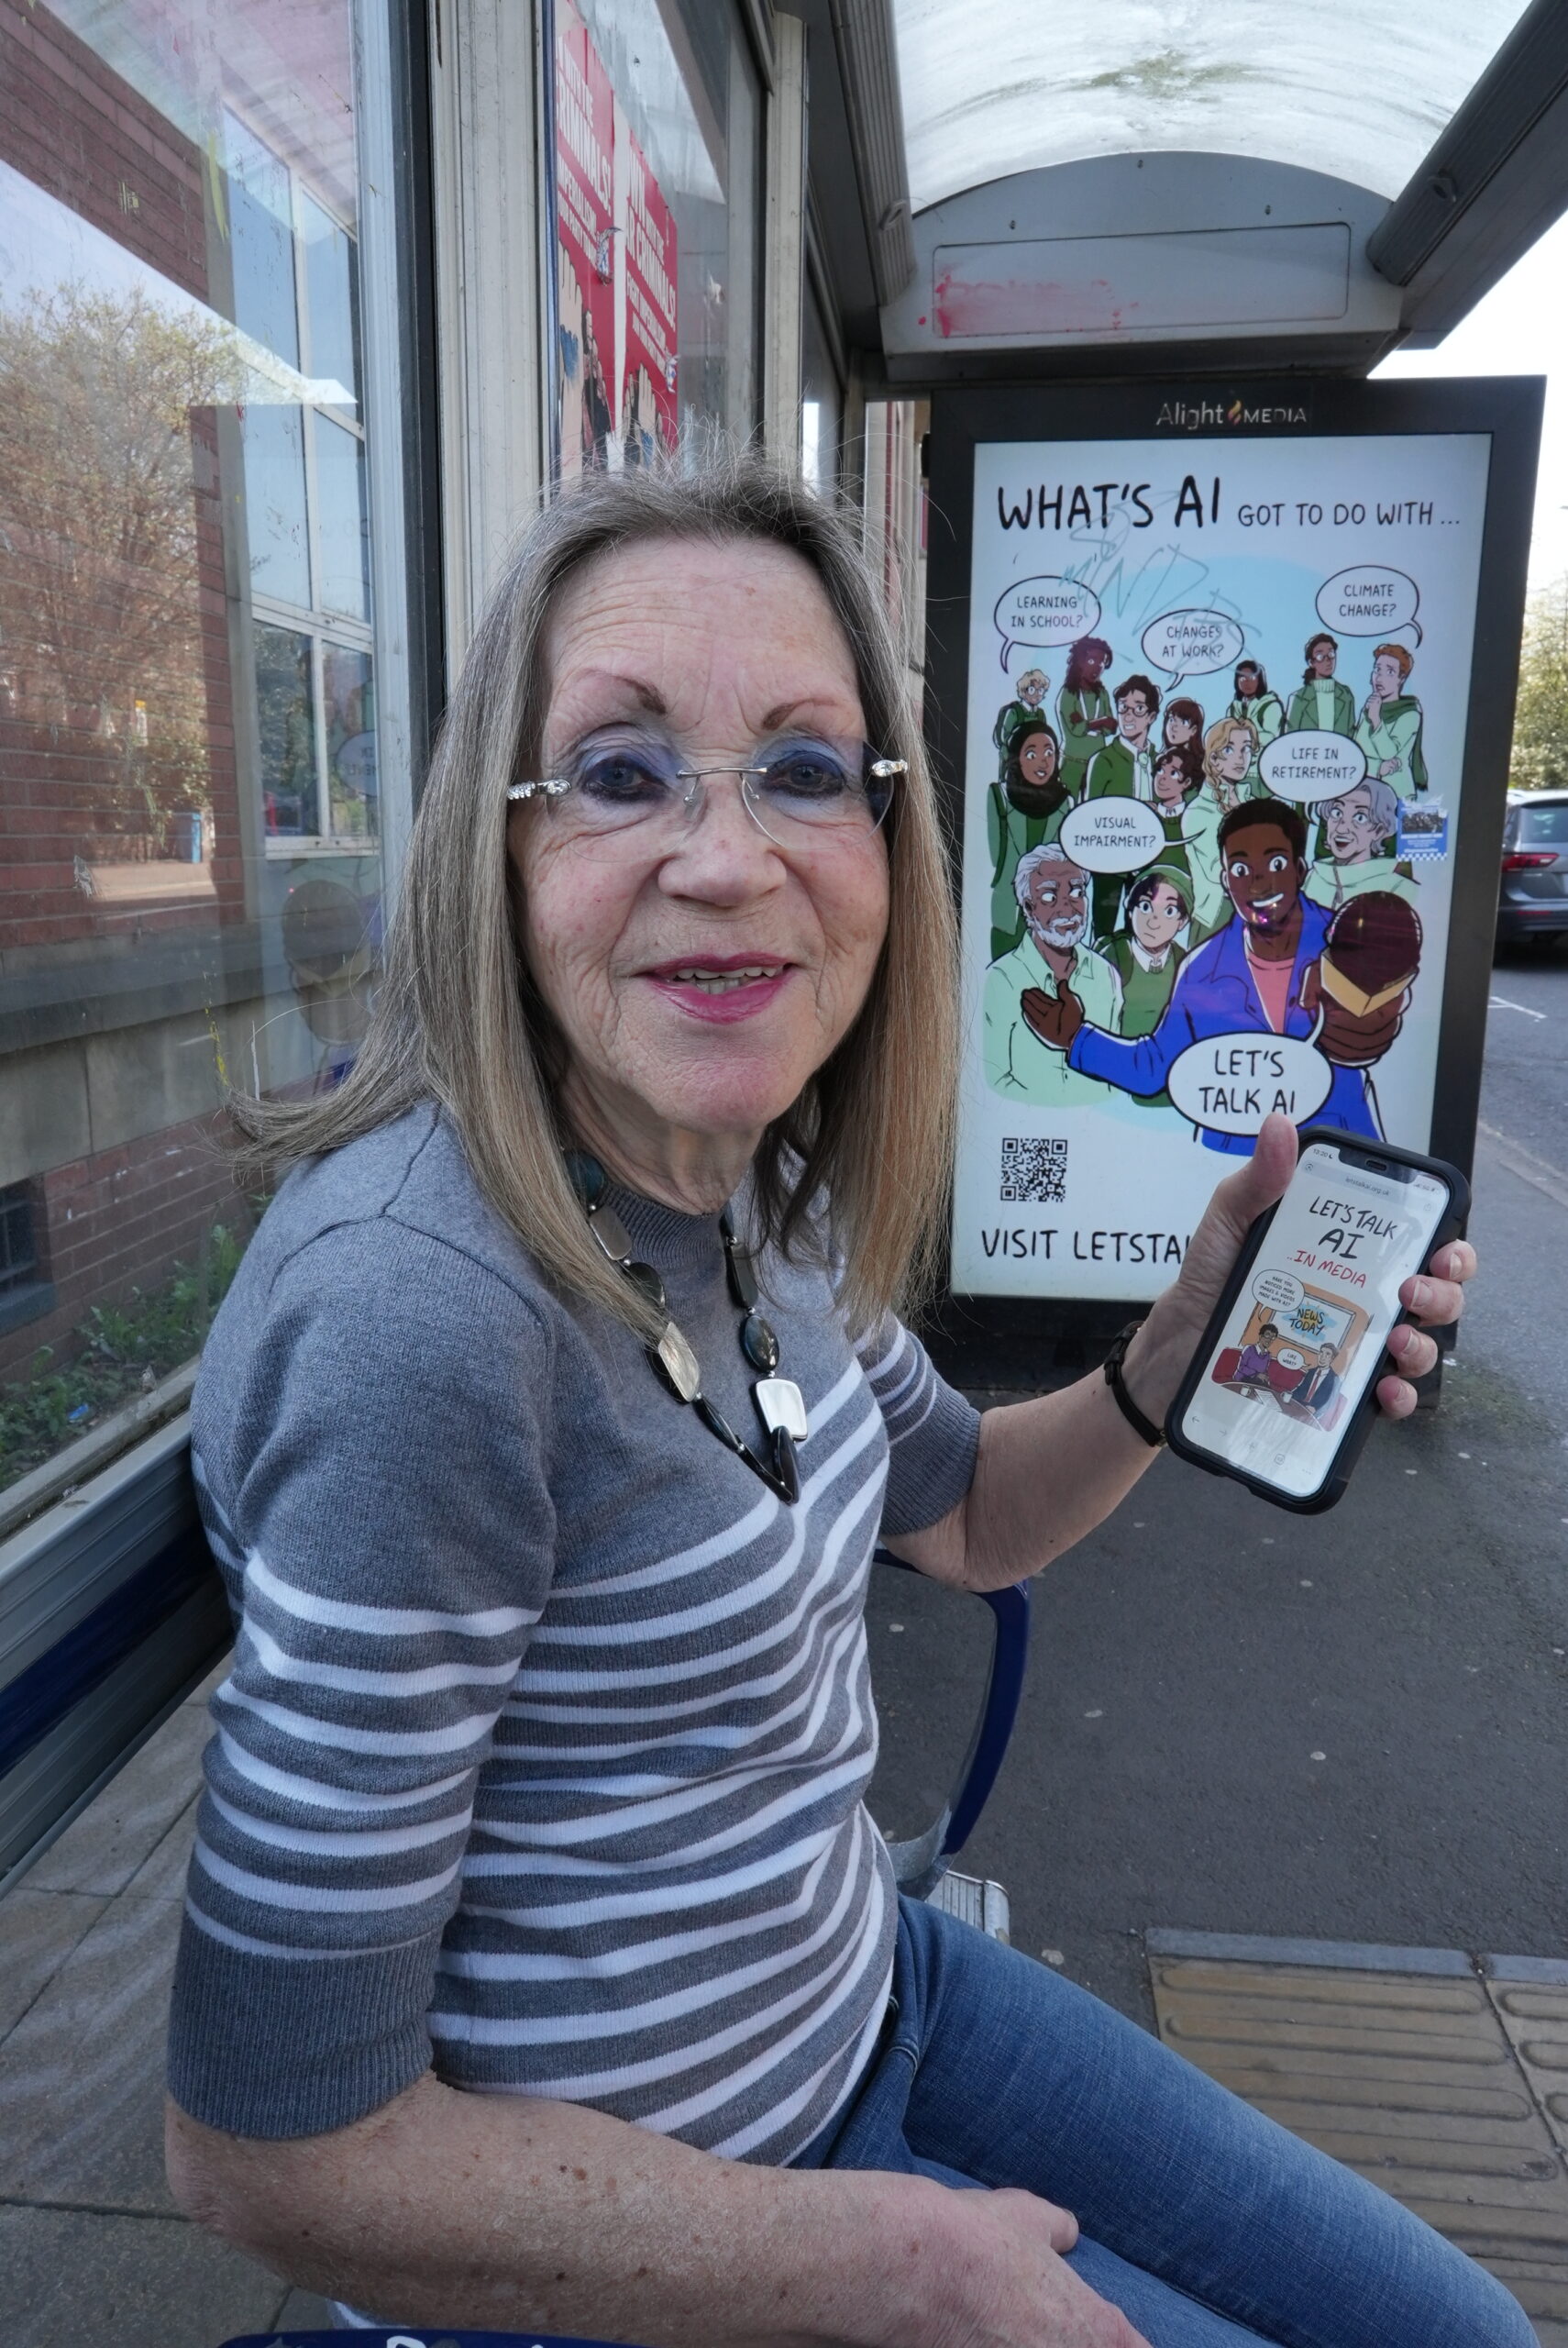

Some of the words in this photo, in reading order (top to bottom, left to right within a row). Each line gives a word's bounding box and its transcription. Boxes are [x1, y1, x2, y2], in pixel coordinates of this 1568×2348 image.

[1156, 402, 1223, 430] Alight
[1243, 407, 1307, 423] MEDIA
[998, 483, 1154, 530] WHAT'S
[1175, 475, 1220, 527] AI
[1238, 504, 1286, 526] GOT
[1296, 504, 1322, 526] TO
[1333, 504, 1365, 526] DO
[1344, 584, 1394, 597] CLIMATE
[1017, 596, 1077, 609] LEARNING
[1339, 604, 1397, 616] CHANGE?
[1010, 615, 1025, 627] IN
[1030, 615, 1083, 627] SCHOOL?
[1166, 626, 1220, 638] CHANGES
[1162, 645, 1176, 658] AT
[1182, 644, 1224, 658] WORK?
[1291, 748, 1320, 759] LIFE
[1324, 748, 1339, 759] IN
[1272, 766, 1357, 779] RETIREMENT?
[1094, 816, 1136, 828] VISUAL
[1074, 835, 1156, 847] IMPAIRMENT?
[1214, 1050, 1284, 1077] LET'S
[1198, 1087, 1261, 1114] TALK
[1272, 1089, 1295, 1114] AI
[1309, 1195, 1355, 1224] LET'S
[1355, 1210, 1397, 1240] TALK
[981, 1229, 1058, 1259] VISIT
[1318, 1228, 1364, 1259] AI
[1317, 1260, 1366, 1288] MEDIA
[1297, 1309, 1324, 1324] NEWS
[1289, 1318, 1325, 1335] TODAY
